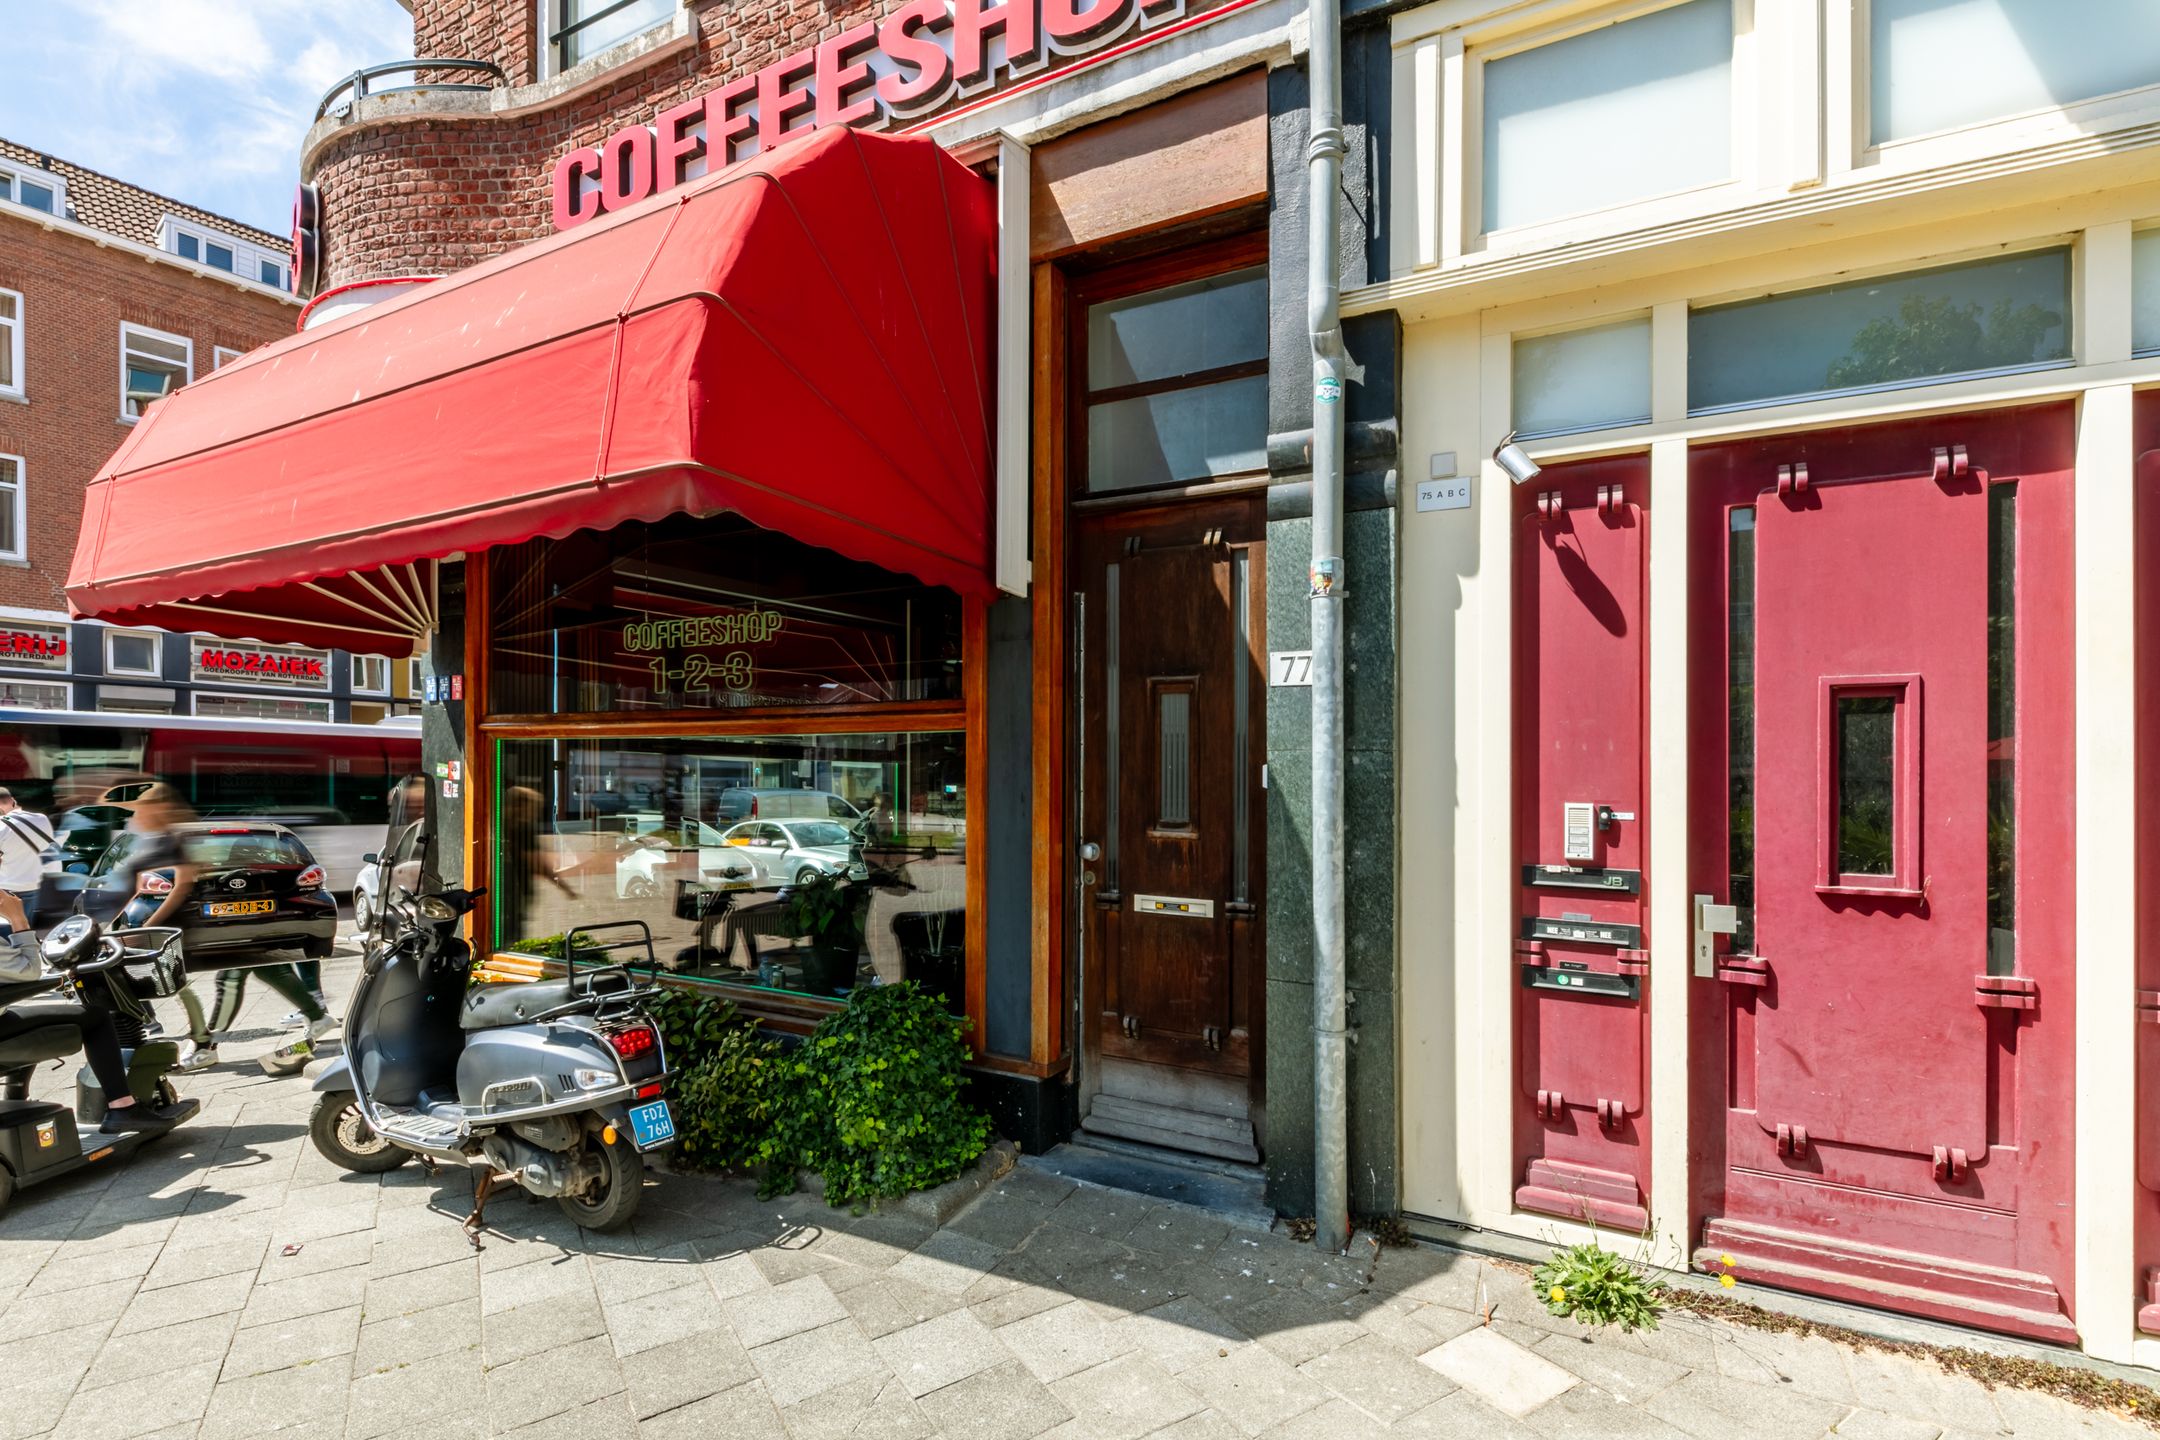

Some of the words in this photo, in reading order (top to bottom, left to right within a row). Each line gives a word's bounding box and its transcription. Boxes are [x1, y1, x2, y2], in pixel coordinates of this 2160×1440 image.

[553, 0, 1165, 231] COFFEESH
[1422, 492, 1432, 500] 75
[1459, 488, 1465, 496] C
[623, 611, 783, 651] COFFEESHOP
[201, 650, 324, 677] MOZAIEK
[203, 666, 259, 677] GOEDKOOPSTE
[277, 673, 320, 681] ROTTERDAM
[649, 651, 753, 694] 1-2-3
[1280, 655, 1312, 683] 77
[1603, 877, 1623, 887] JB
[642, 1105, 665, 1122] FDZ
[646, 1120, 670, 1138] 76H
